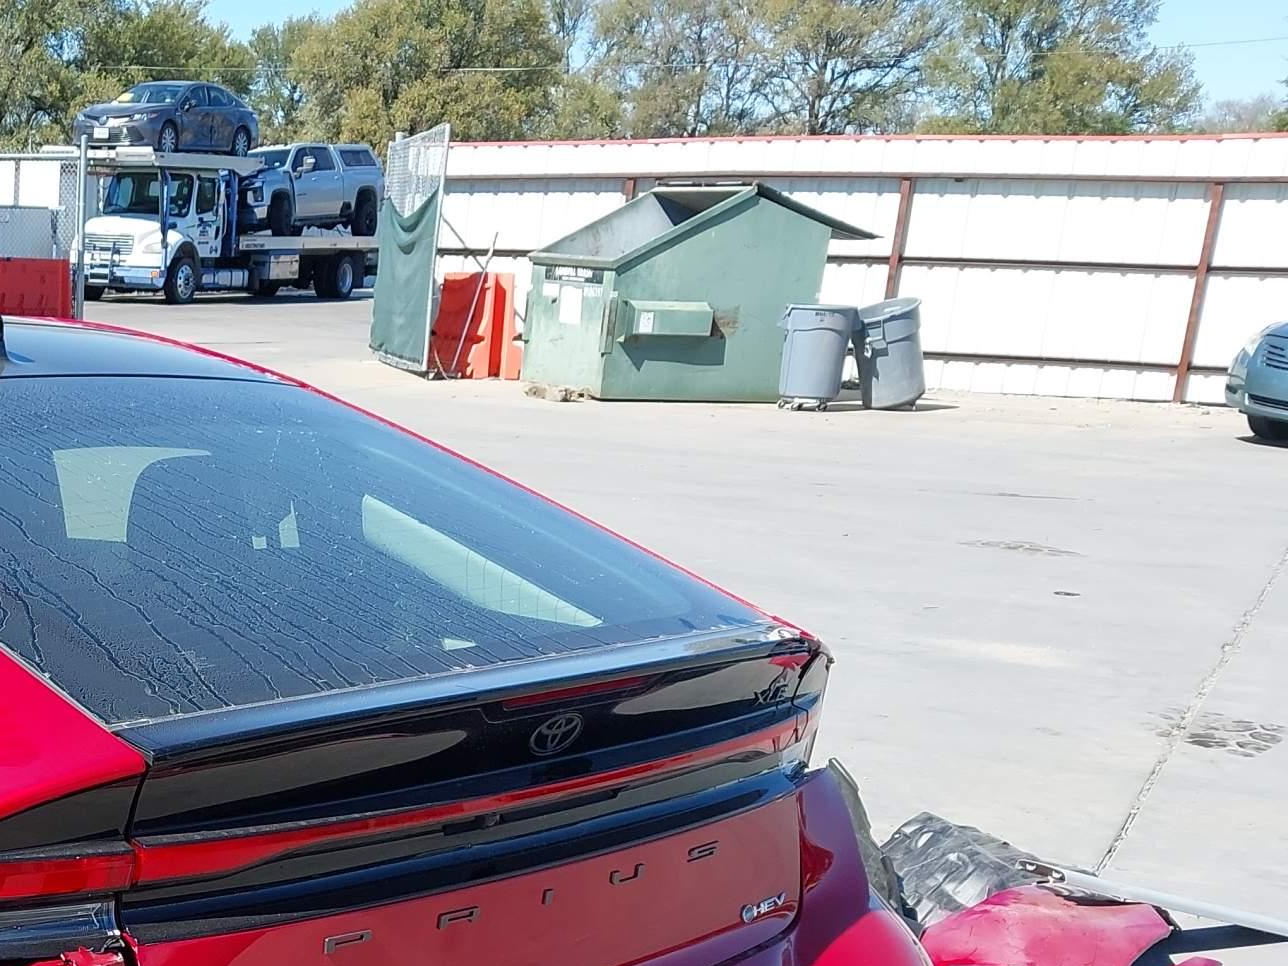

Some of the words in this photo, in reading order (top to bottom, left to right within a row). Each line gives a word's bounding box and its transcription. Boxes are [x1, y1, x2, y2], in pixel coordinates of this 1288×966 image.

[753, 683, 789, 706] XLE
[322, 840, 720, 954] PRIUS
[752, 892, 787, 917] HEV
